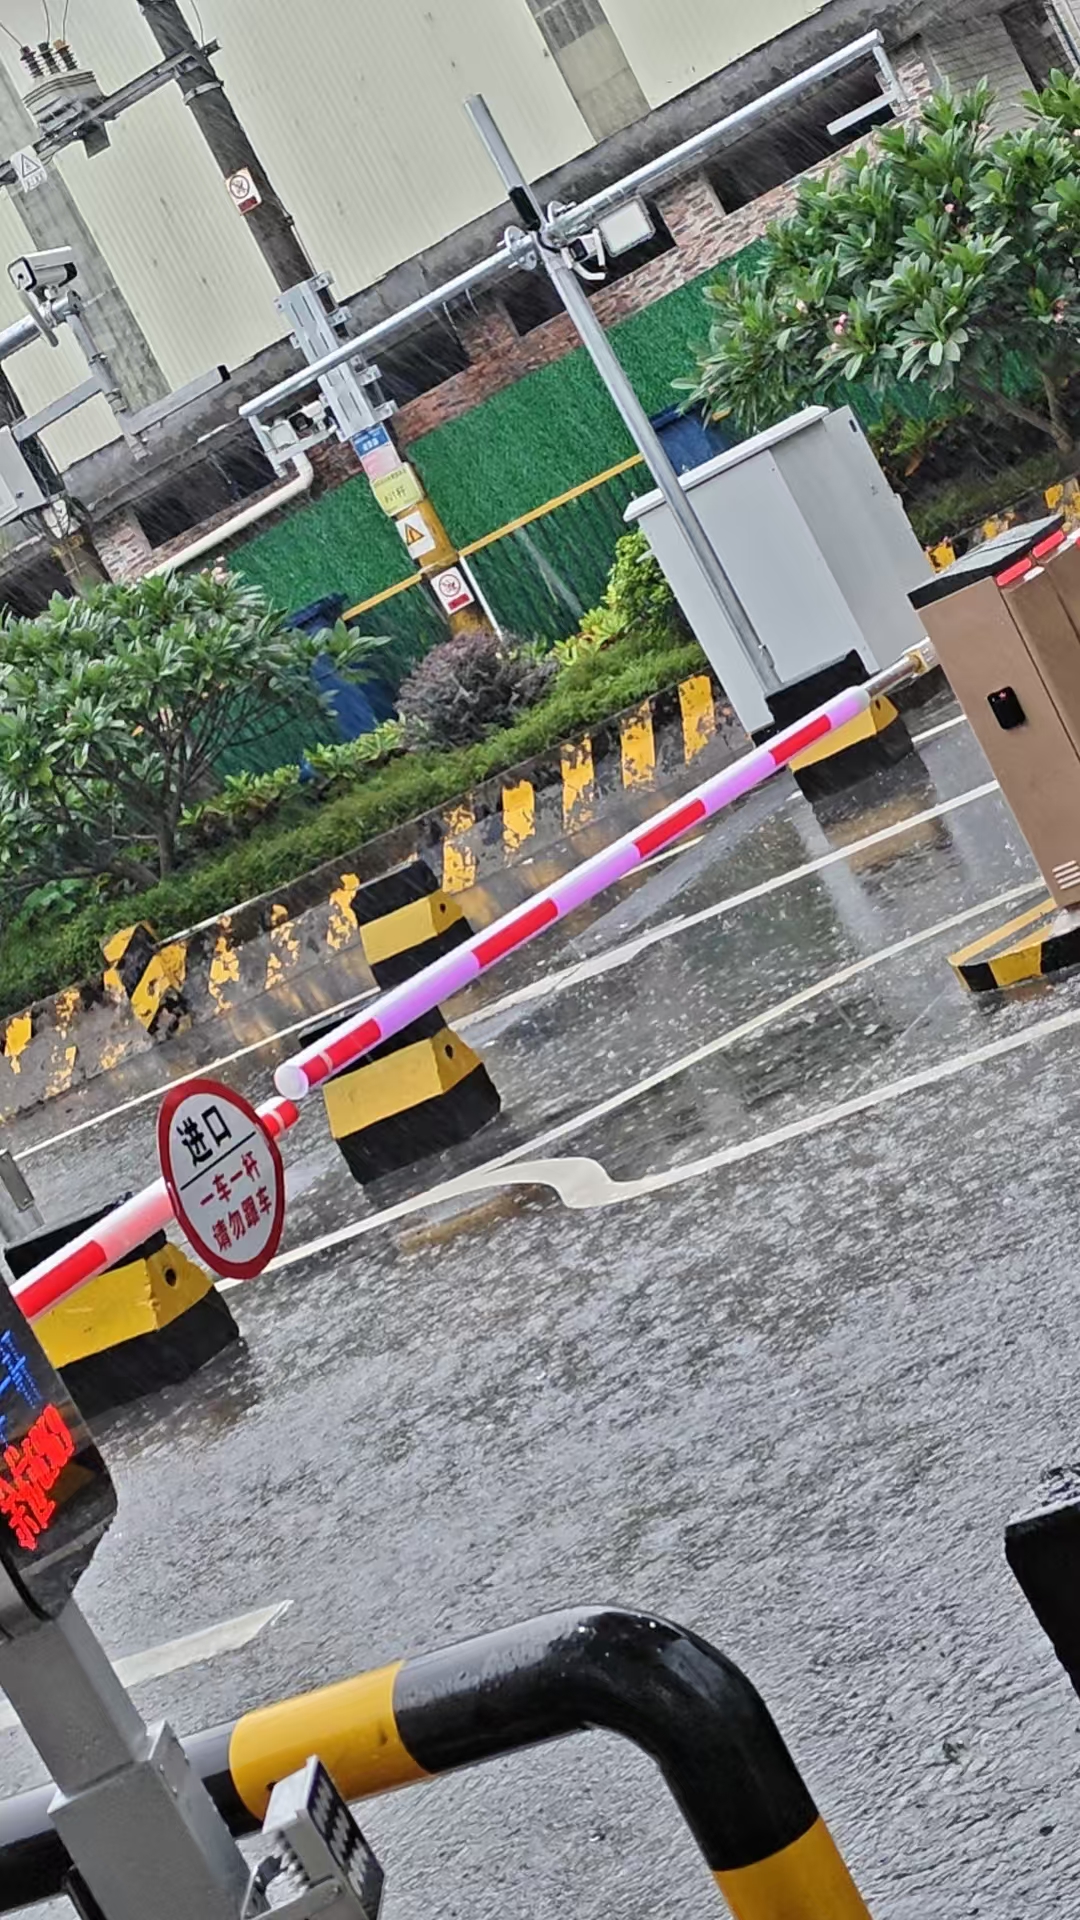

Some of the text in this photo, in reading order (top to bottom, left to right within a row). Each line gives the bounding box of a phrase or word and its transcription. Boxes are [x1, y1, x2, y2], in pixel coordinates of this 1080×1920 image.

[176, 1105, 232, 1167] 进口
[200, 1151, 261, 1206] 一车一杆
[212, 1186, 272, 1252] 请勿跟车
